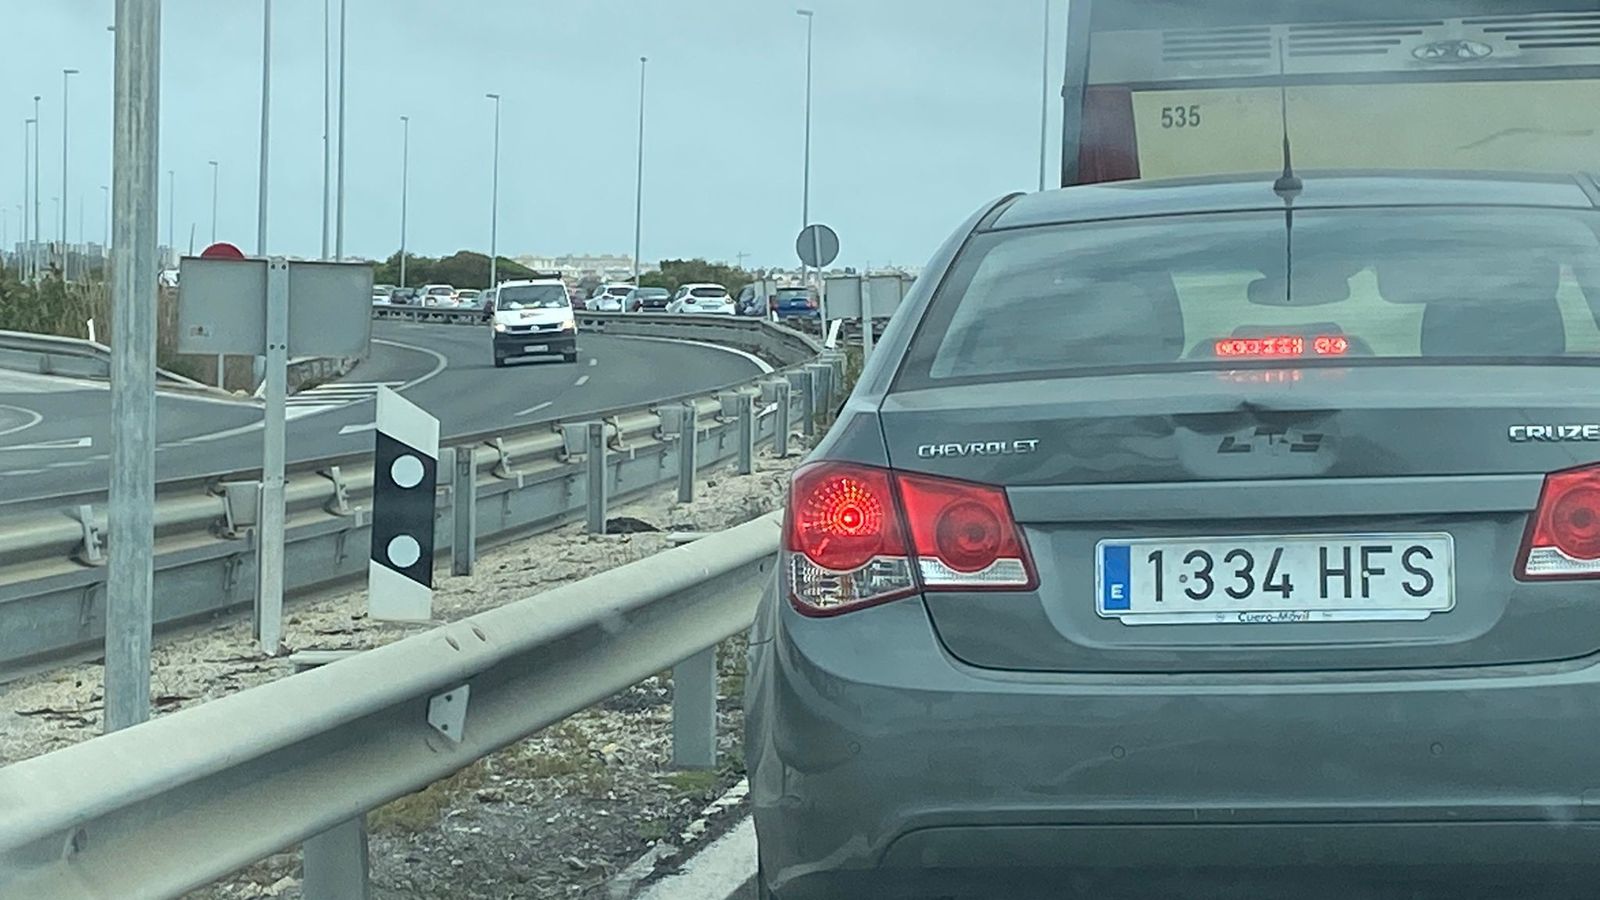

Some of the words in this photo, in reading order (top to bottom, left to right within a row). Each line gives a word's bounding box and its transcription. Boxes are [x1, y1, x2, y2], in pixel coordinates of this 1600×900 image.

[1161, 105, 1201, 129] 535
[1508, 424, 1600, 442] CRUZE
[917, 439, 1040, 458] CHEVROLET
[1147, 546, 1294, 602] 1334
[1318, 544, 1435, 599] HFS
[1110, 583, 1124, 599] E
